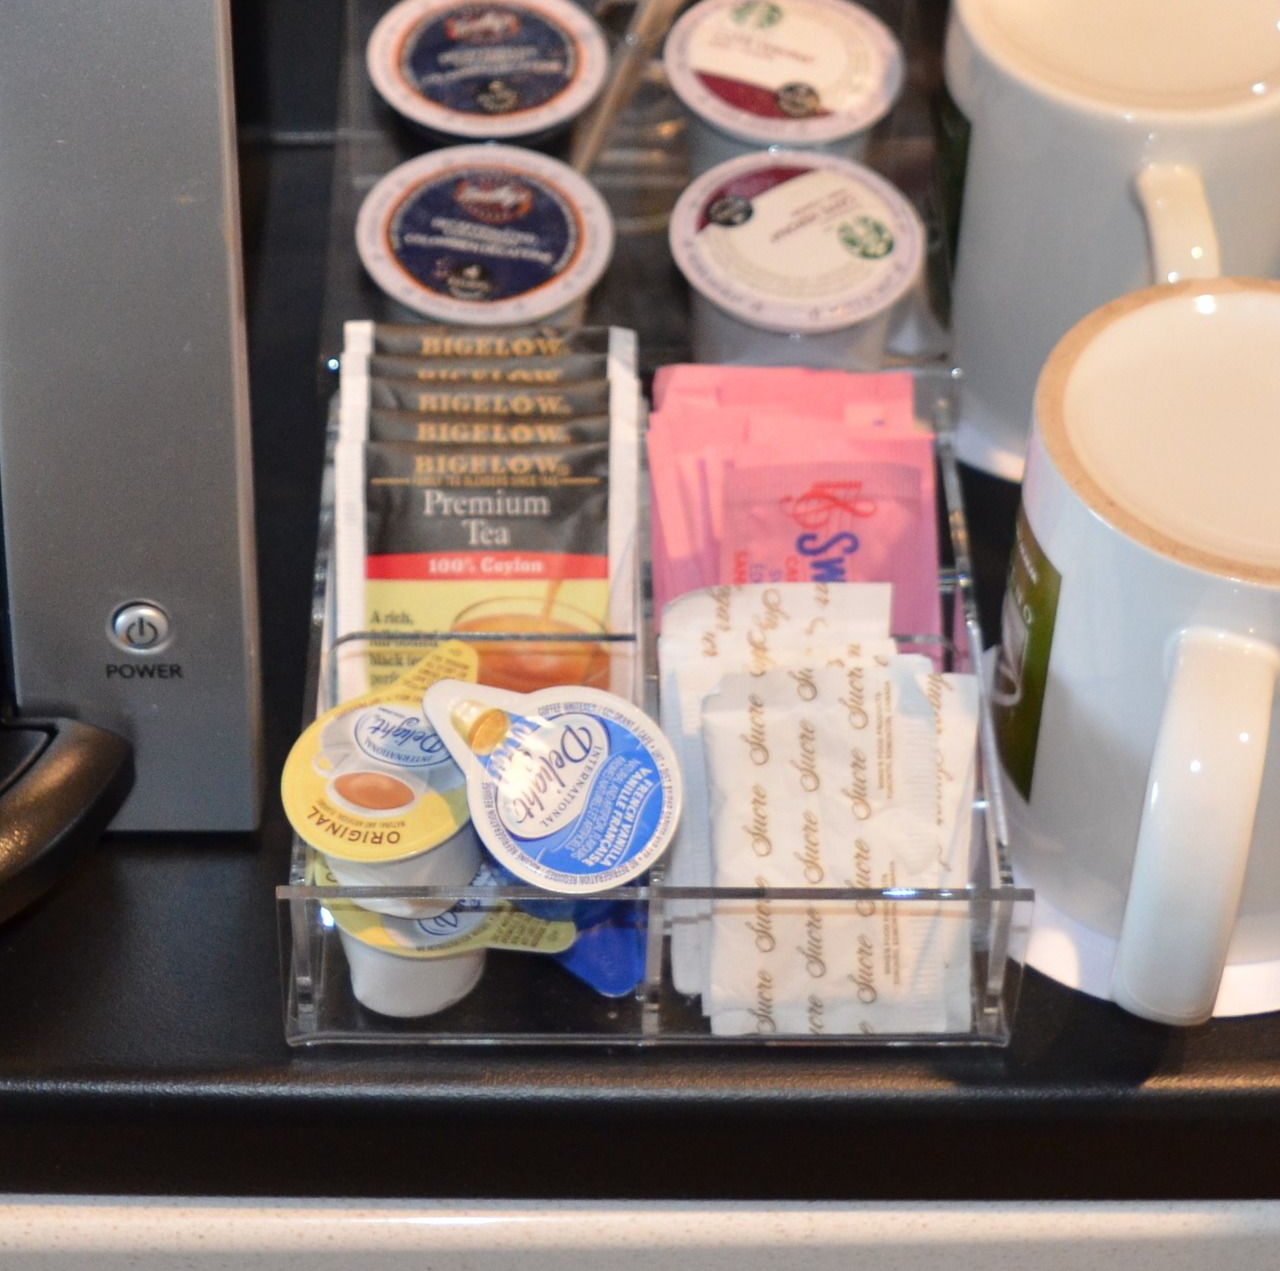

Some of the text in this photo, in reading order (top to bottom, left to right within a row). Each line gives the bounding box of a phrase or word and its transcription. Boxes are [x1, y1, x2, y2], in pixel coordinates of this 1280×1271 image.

[421, 336, 564, 356] BIGELOW
[418, 394, 564, 414] BIGELOW
[417, 422, 564, 442] BIGELOW
[415, 455, 561, 475] BIGELOW
[423, 488, 551, 515] Premium
[462, 518, 511, 545] Tea
[428, 557, 544, 576] 100% Ceylon
[106, 663, 183, 679] POWER
[363, 740, 433, 765] INTERNATIONAL
[366, 716, 445, 754] Delight
[740, 694, 770, 765] Sucre
[789, 718, 821, 792] Sucre
[512, 725, 593, 821] Delight
[540, 745, 603, 829] INTERNATIONAL
[841, 748, 872, 820] Sucre
[307, 804, 401, 845] ORIGINAL
[582, 766, 653, 867] VANILLE FRANÇAISE
[600, 778, 653, 868] FRENCH VANILLA
[742, 783, 773, 856] Sucre
[793, 810, 825, 884] Sucre
[797, 908, 827, 978] Sucre
[847, 934, 878, 1004] Sucre
